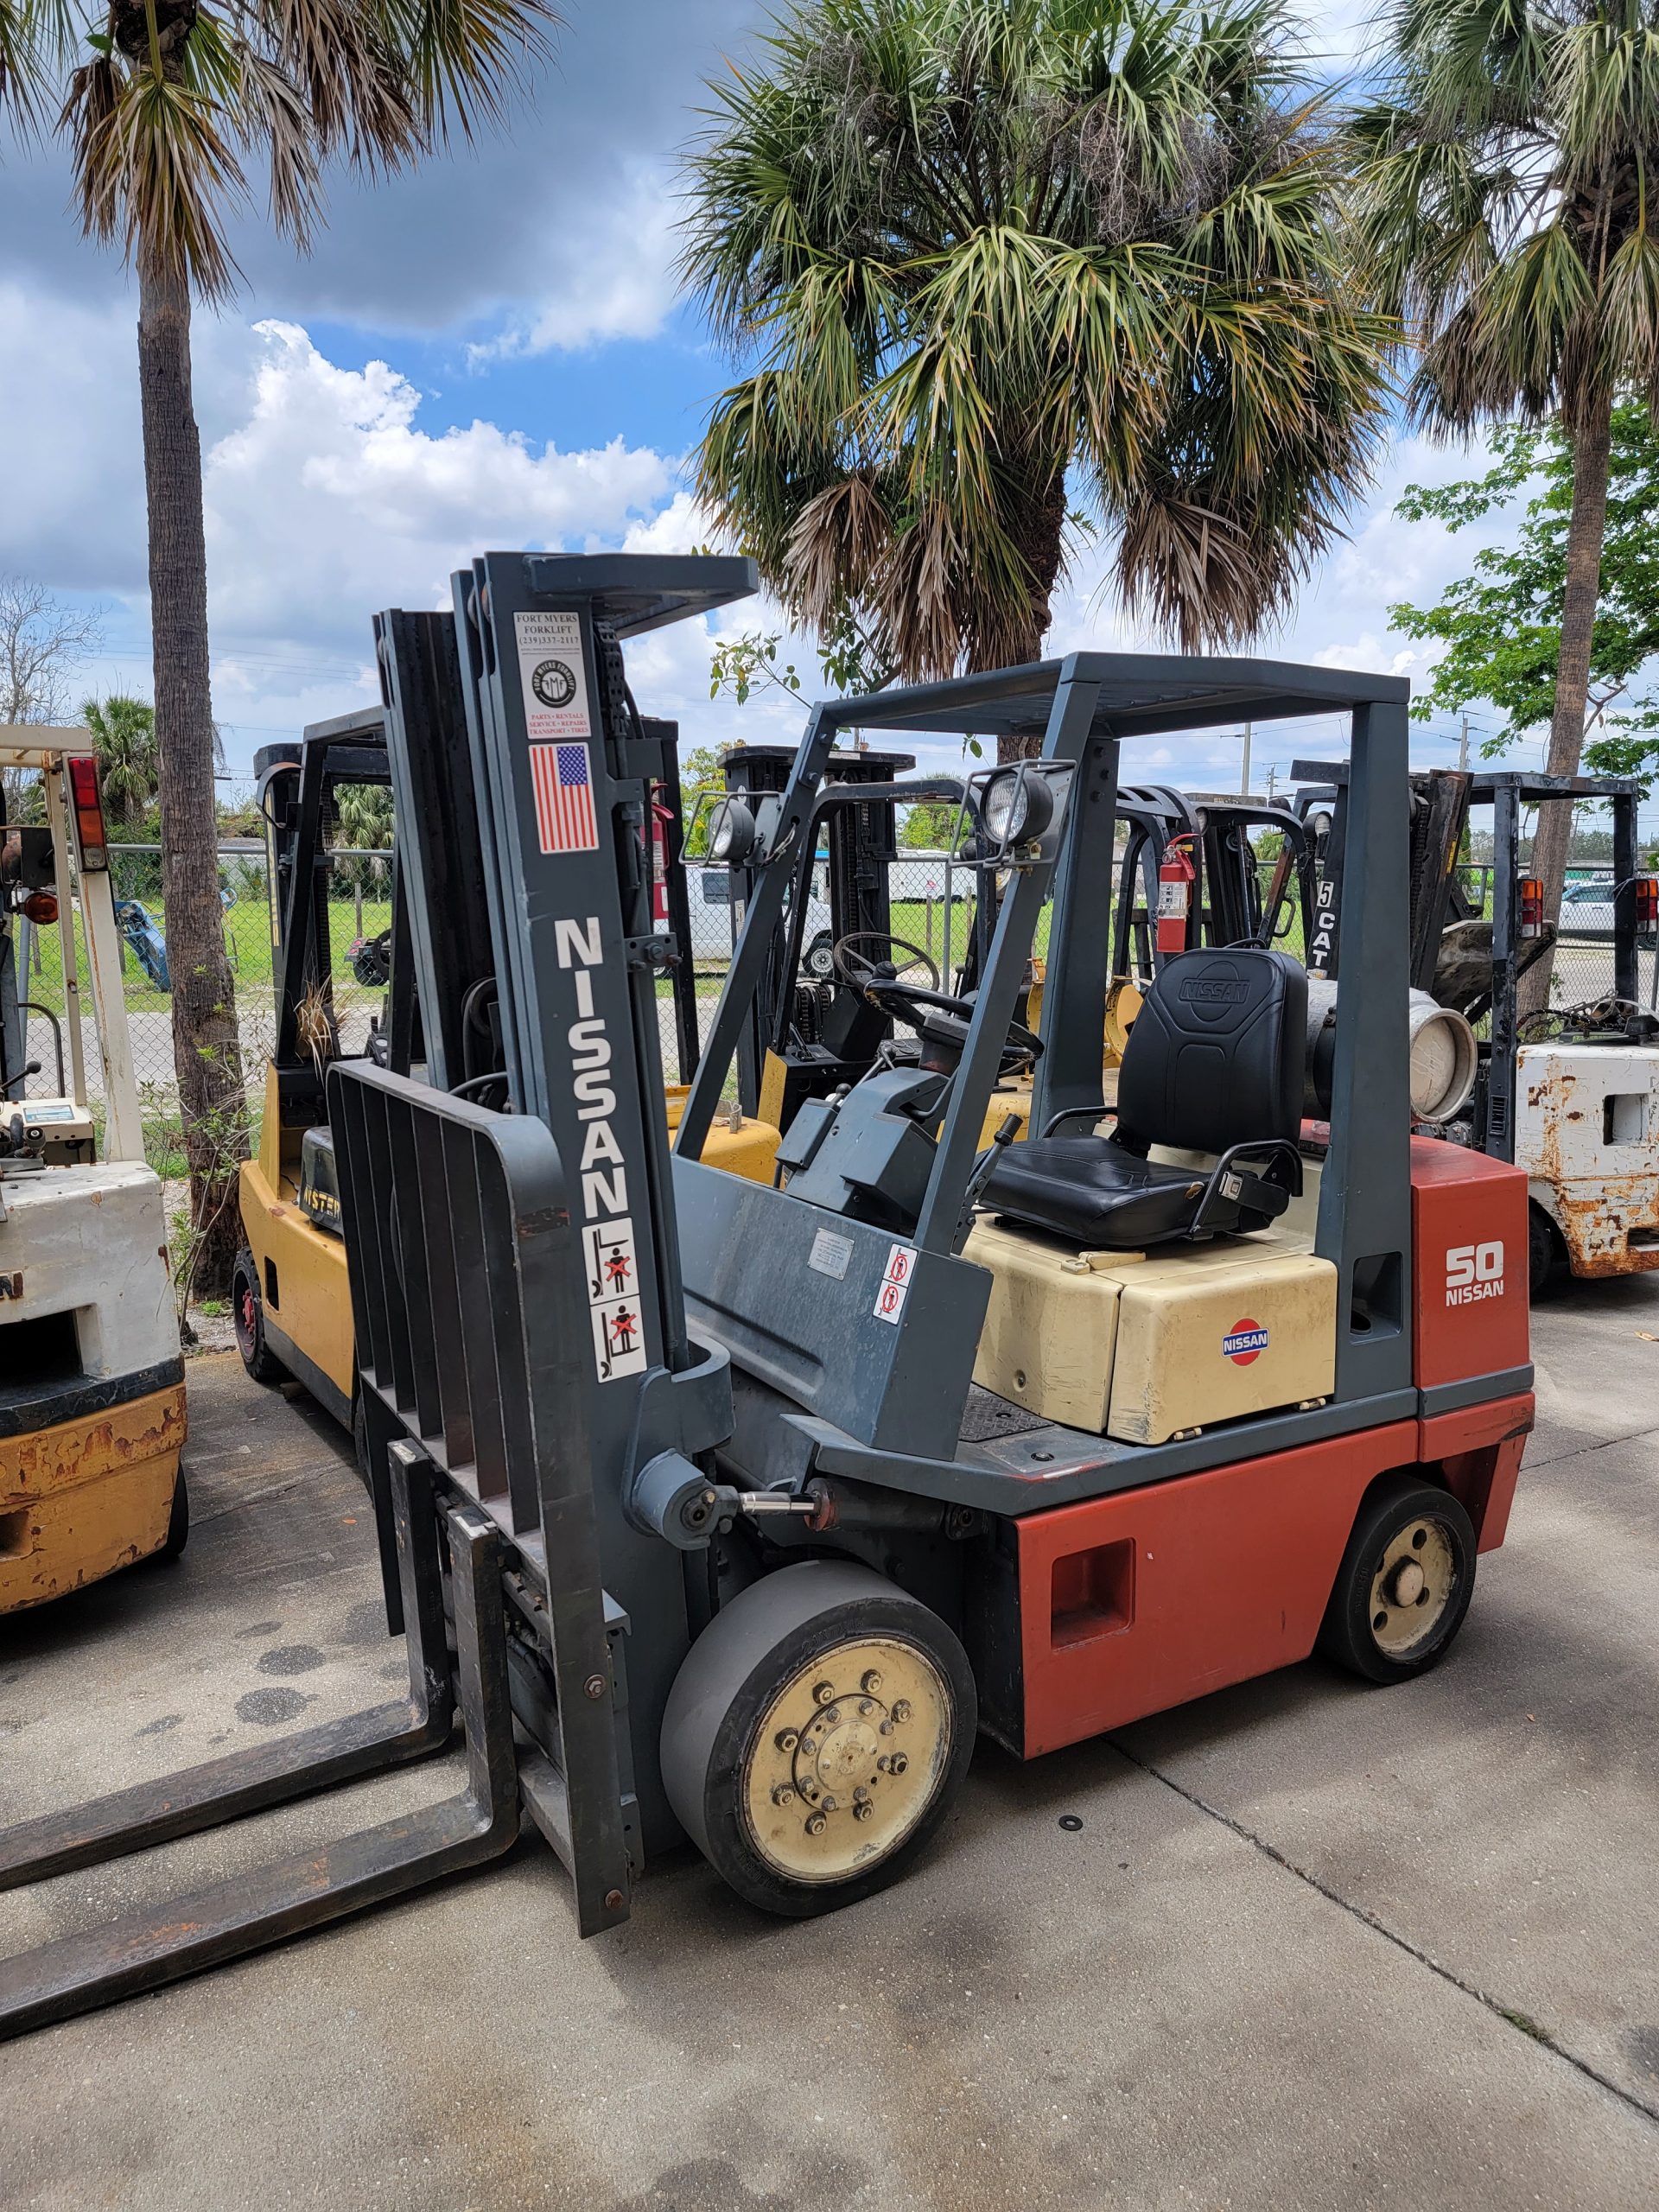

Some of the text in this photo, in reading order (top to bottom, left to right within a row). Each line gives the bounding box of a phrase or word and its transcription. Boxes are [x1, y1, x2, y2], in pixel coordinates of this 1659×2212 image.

[519, 636, 579, 645] (239)337-2117
[1319, 882, 1332, 906] 5
[1313, 912, 1336, 967] CAT
[1182, 982, 1249, 1001] NISSAN
[554, 917, 629, 1219] NISSAN
[1446, 1241, 1503, 1287] 50
[1446, 1280, 1503, 1306] NISSAN
[1224, 1332, 1268, 1352] NISSAN
